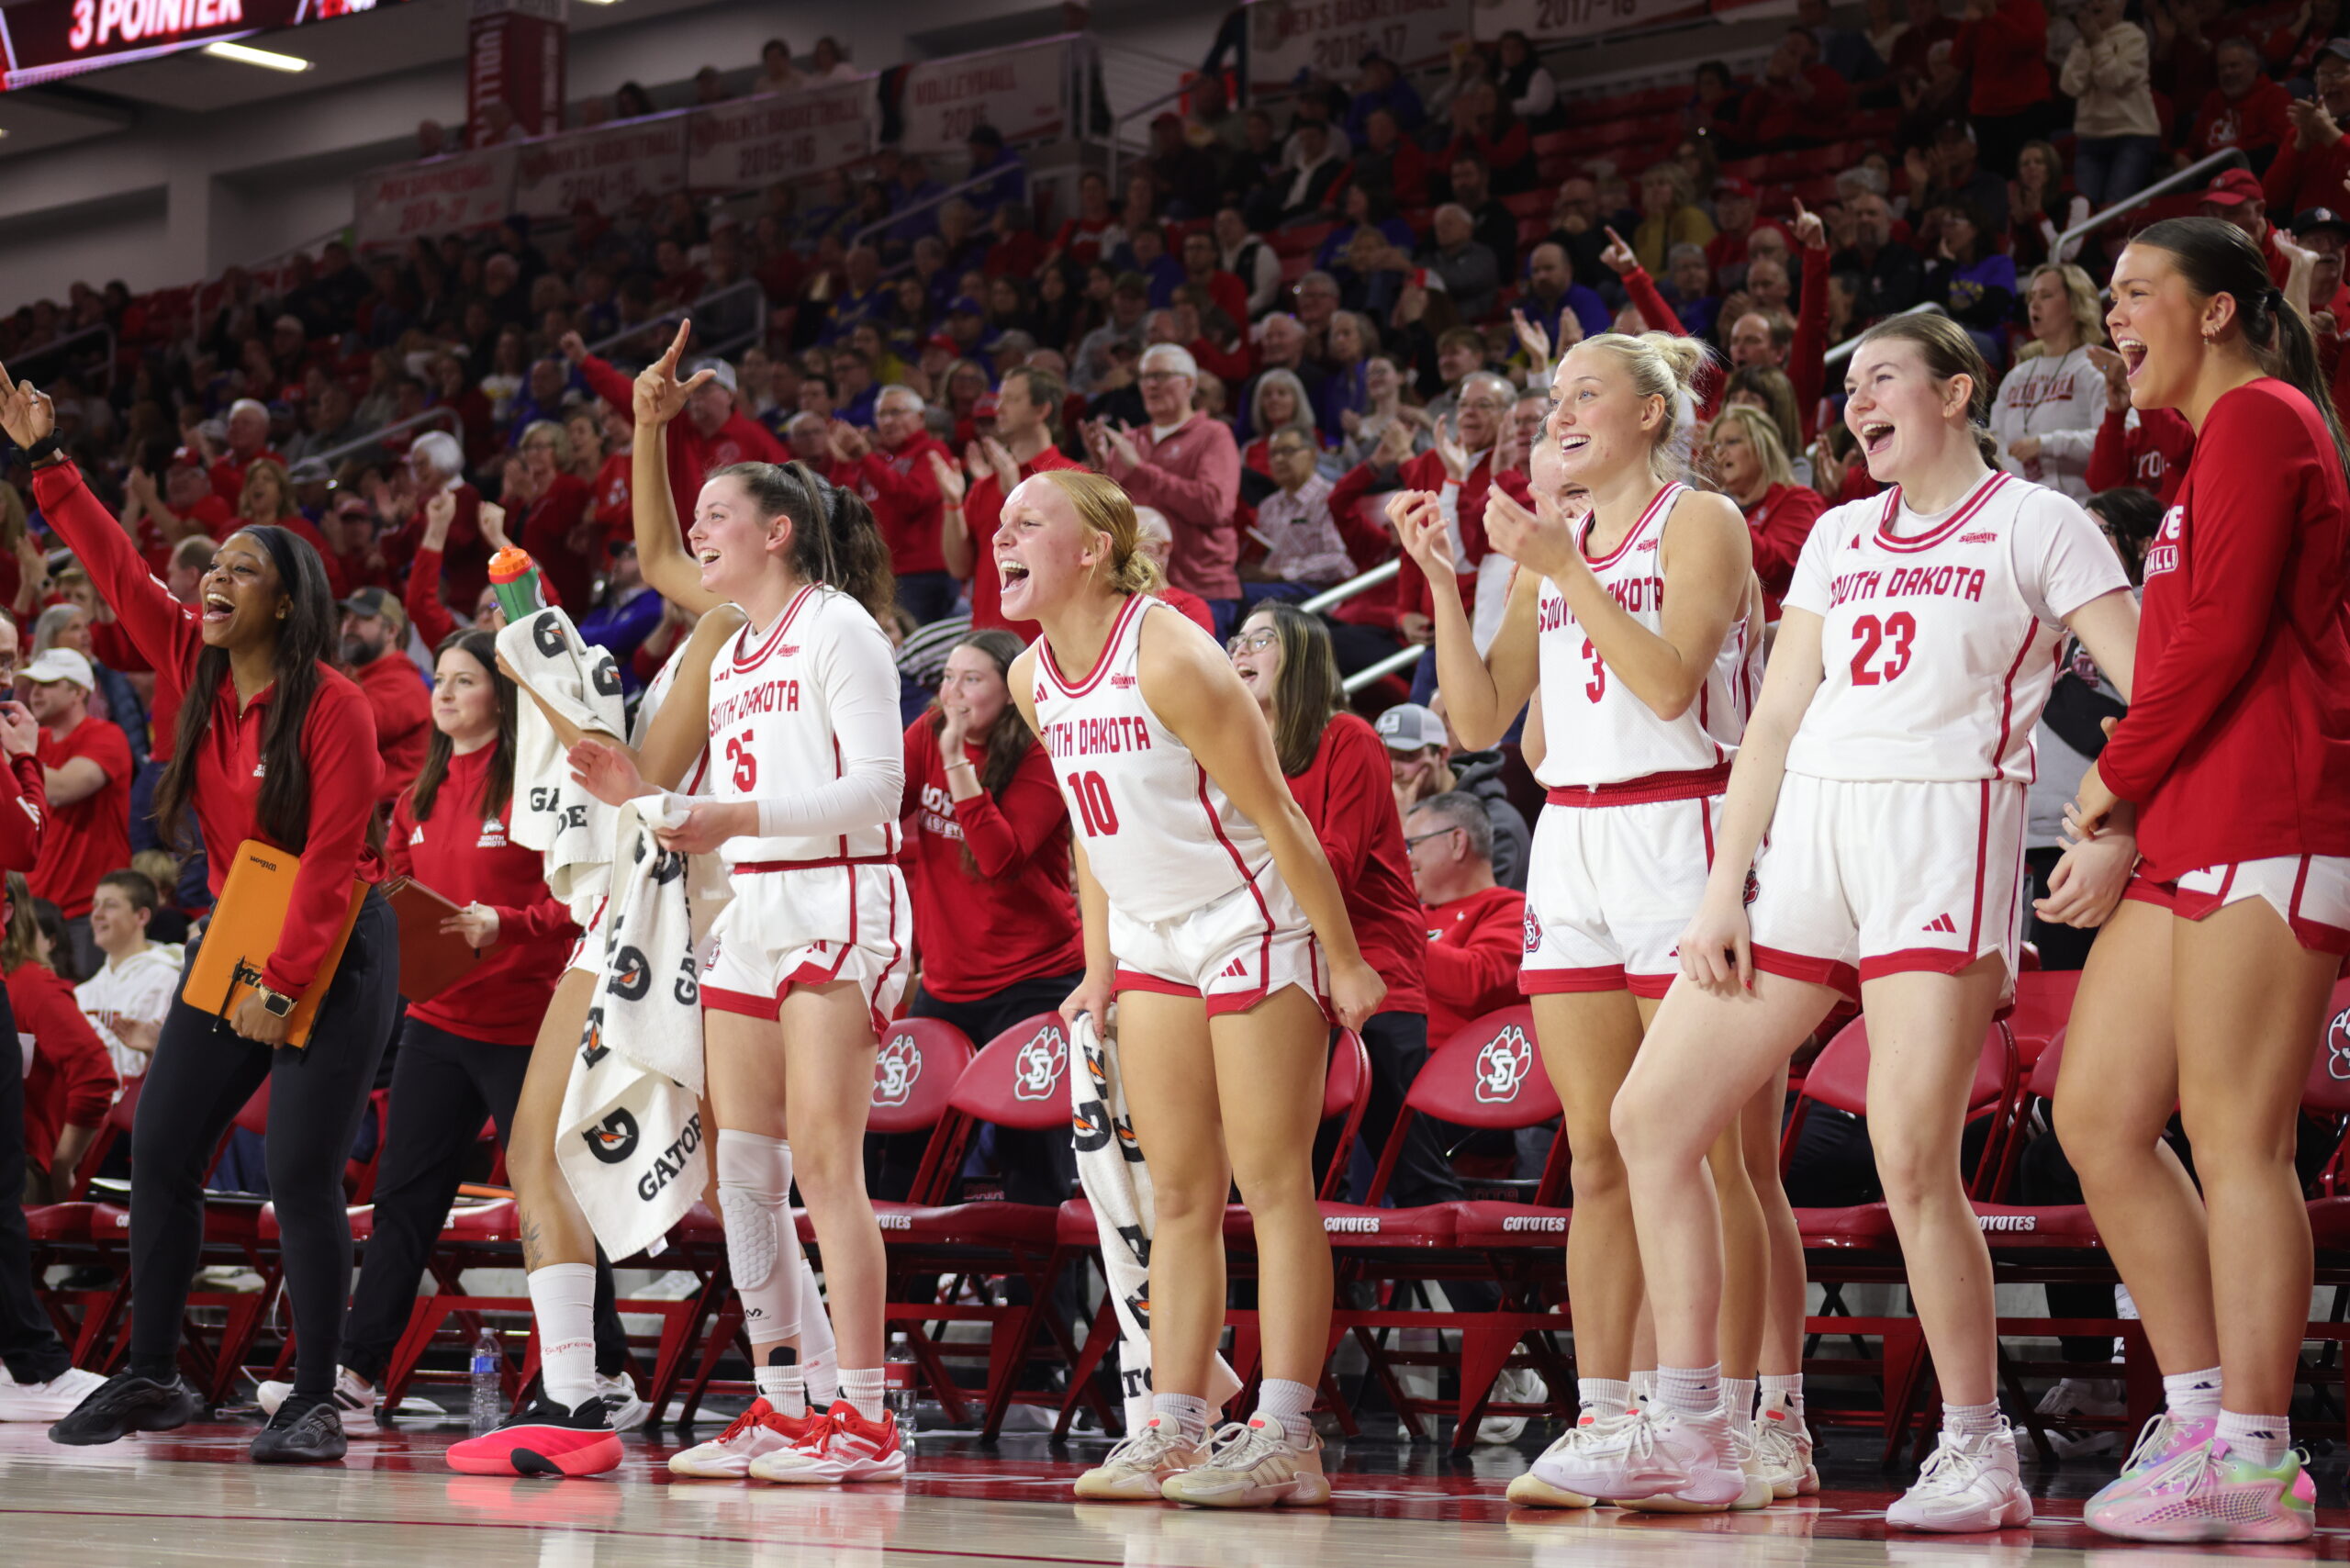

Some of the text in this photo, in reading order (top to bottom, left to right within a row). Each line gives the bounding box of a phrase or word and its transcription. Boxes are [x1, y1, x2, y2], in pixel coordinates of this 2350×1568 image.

[70, 0, 94, 50] 3
[1886, 566, 1986, 602] DAKOTA
[1850, 610, 1917, 687] 23
[1582, 636, 1606, 704] 3
[738, 679, 800, 721] DAKOTA
[1080, 716, 1151, 756] DAKOTA
[1067, 770, 1120, 838] 10
[250, 854, 277, 871] Wilson
[1323, 1216, 1381, 1233] COYOTES
[1502, 1215, 1567, 1233] COYOTES
[1976, 1215, 2037, 1231] OYOTES
